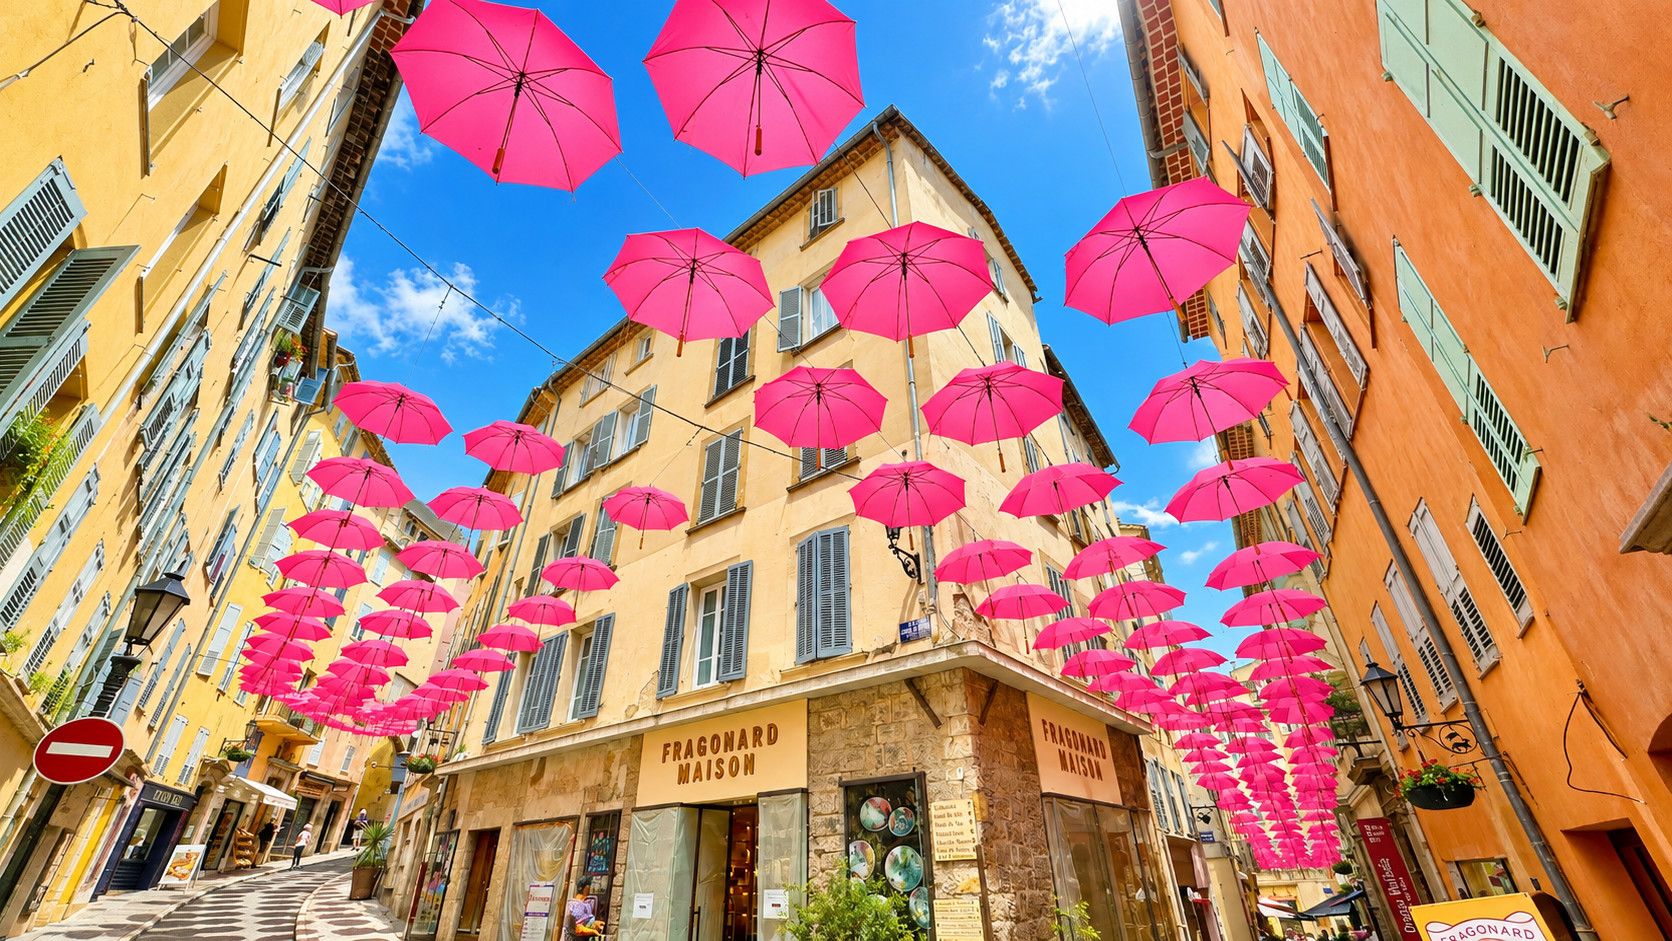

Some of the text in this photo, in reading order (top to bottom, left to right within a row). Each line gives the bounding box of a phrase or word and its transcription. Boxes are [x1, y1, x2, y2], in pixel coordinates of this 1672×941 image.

[662, 723, 778, 763] FRAGONARD
[1041, 718, 1107, 760] FRAGONARD
[677, 753, 755, 785] MAISON
[1058, 748, 1103, 781] MAISON
